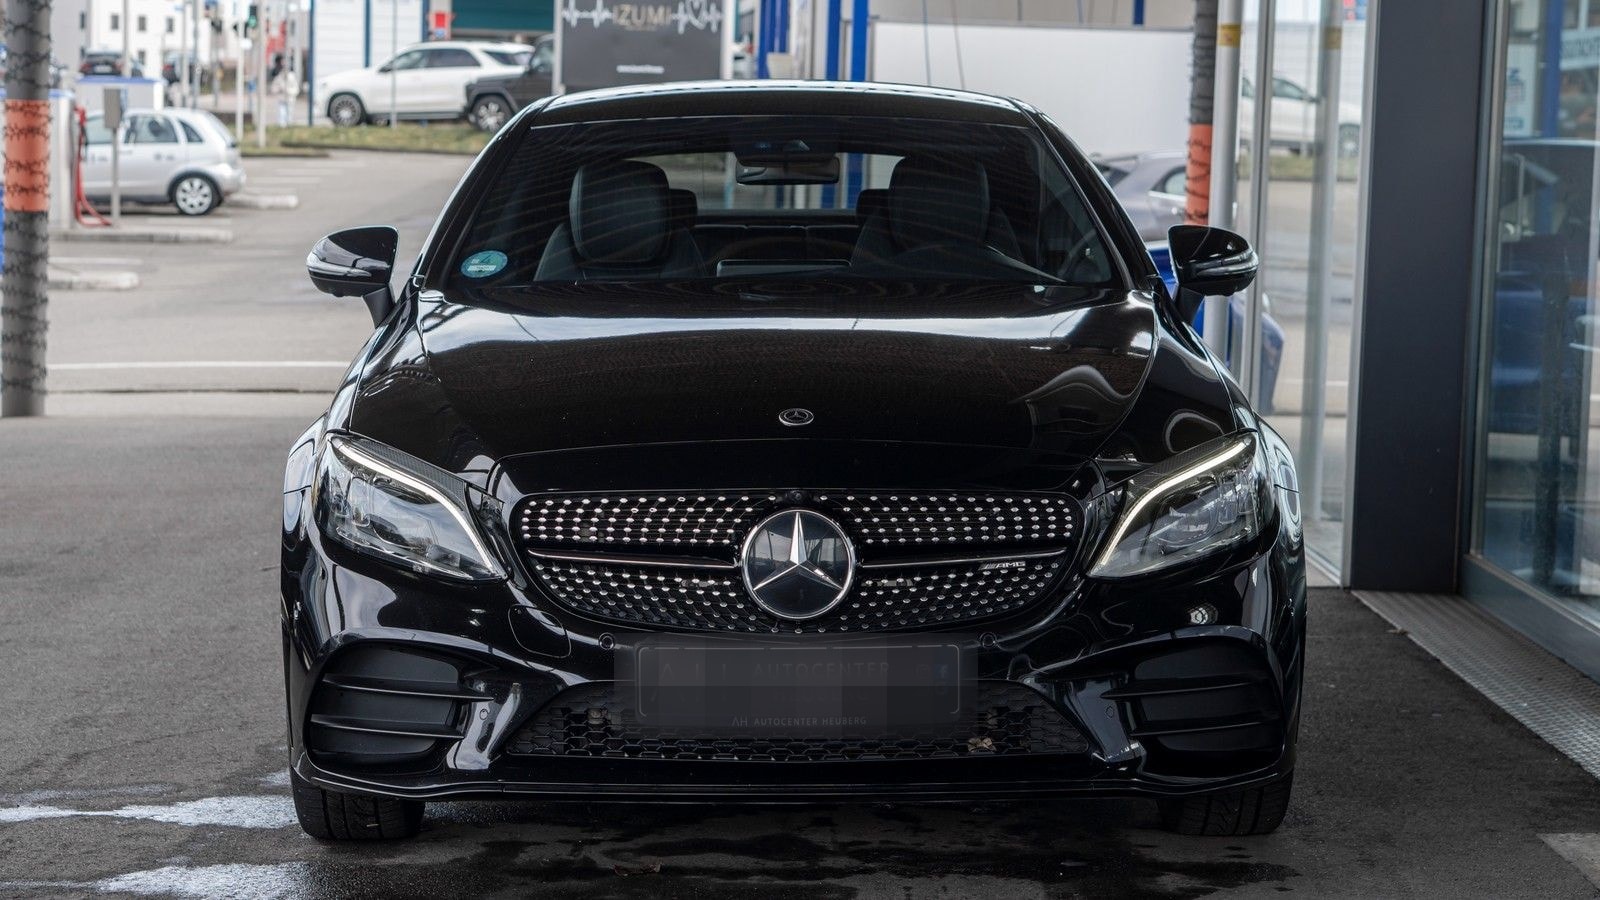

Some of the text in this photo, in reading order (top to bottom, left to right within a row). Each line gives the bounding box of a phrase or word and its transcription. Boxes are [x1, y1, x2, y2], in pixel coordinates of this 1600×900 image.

[613, 4, 672, 26] IZUMI
[754, 717, 818, 726] AUTOCENTER
[822, 716, 867, 726] HEUBERG
